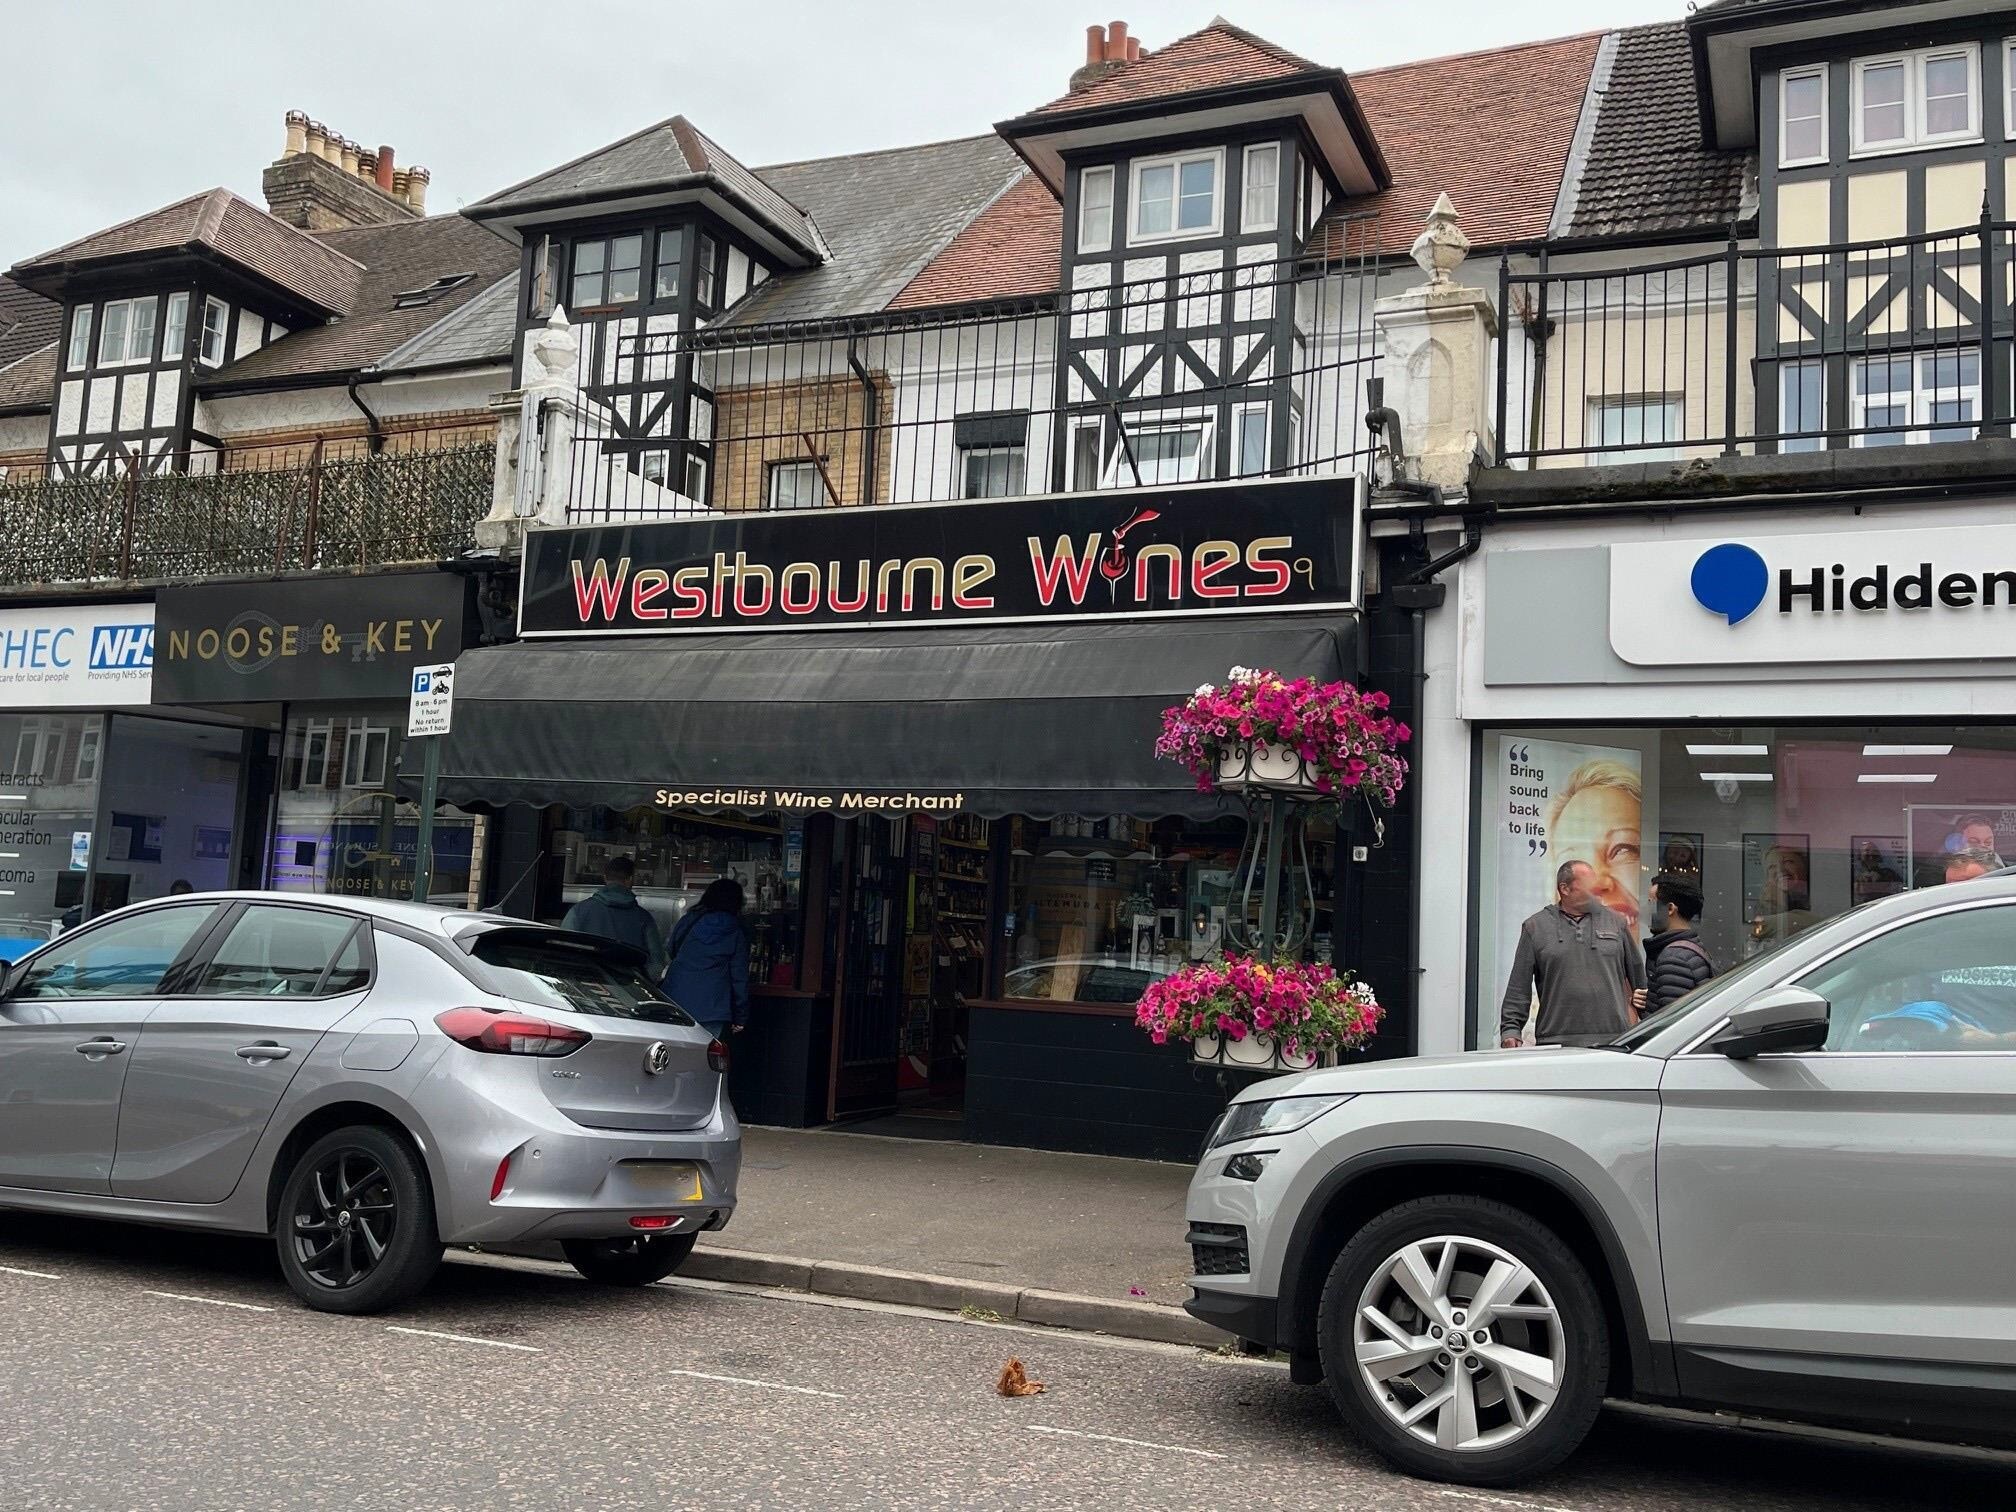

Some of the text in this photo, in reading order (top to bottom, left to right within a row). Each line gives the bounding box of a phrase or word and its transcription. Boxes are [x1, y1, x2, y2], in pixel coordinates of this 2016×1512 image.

[571, 551, 996, 622] Westbourne
[1779, 563, 2016, 613] Hidden
[168, 618, 443, 660] NOOSE & KEY
[0, 627, 75, 669] HEC
[15, 672, 25, 681] for
[26, 672, 43, 682] local
[44, 672, 70, 682] people
[88, 671, 121, 681] Providing
[122, 670, 137, 679] NHS
[417, 674, 428, 691] P
[1510, 763, 1544, 781] Bring
[655, 789, 964, 809] Specialist Wine Merchant
[1509, 785, 1548, 798] sound
[1509, 801, 1540, 816] back
[1508, 821, 1545, 836] to life
[327, 878, 417, 890] NOOSE & KEY
